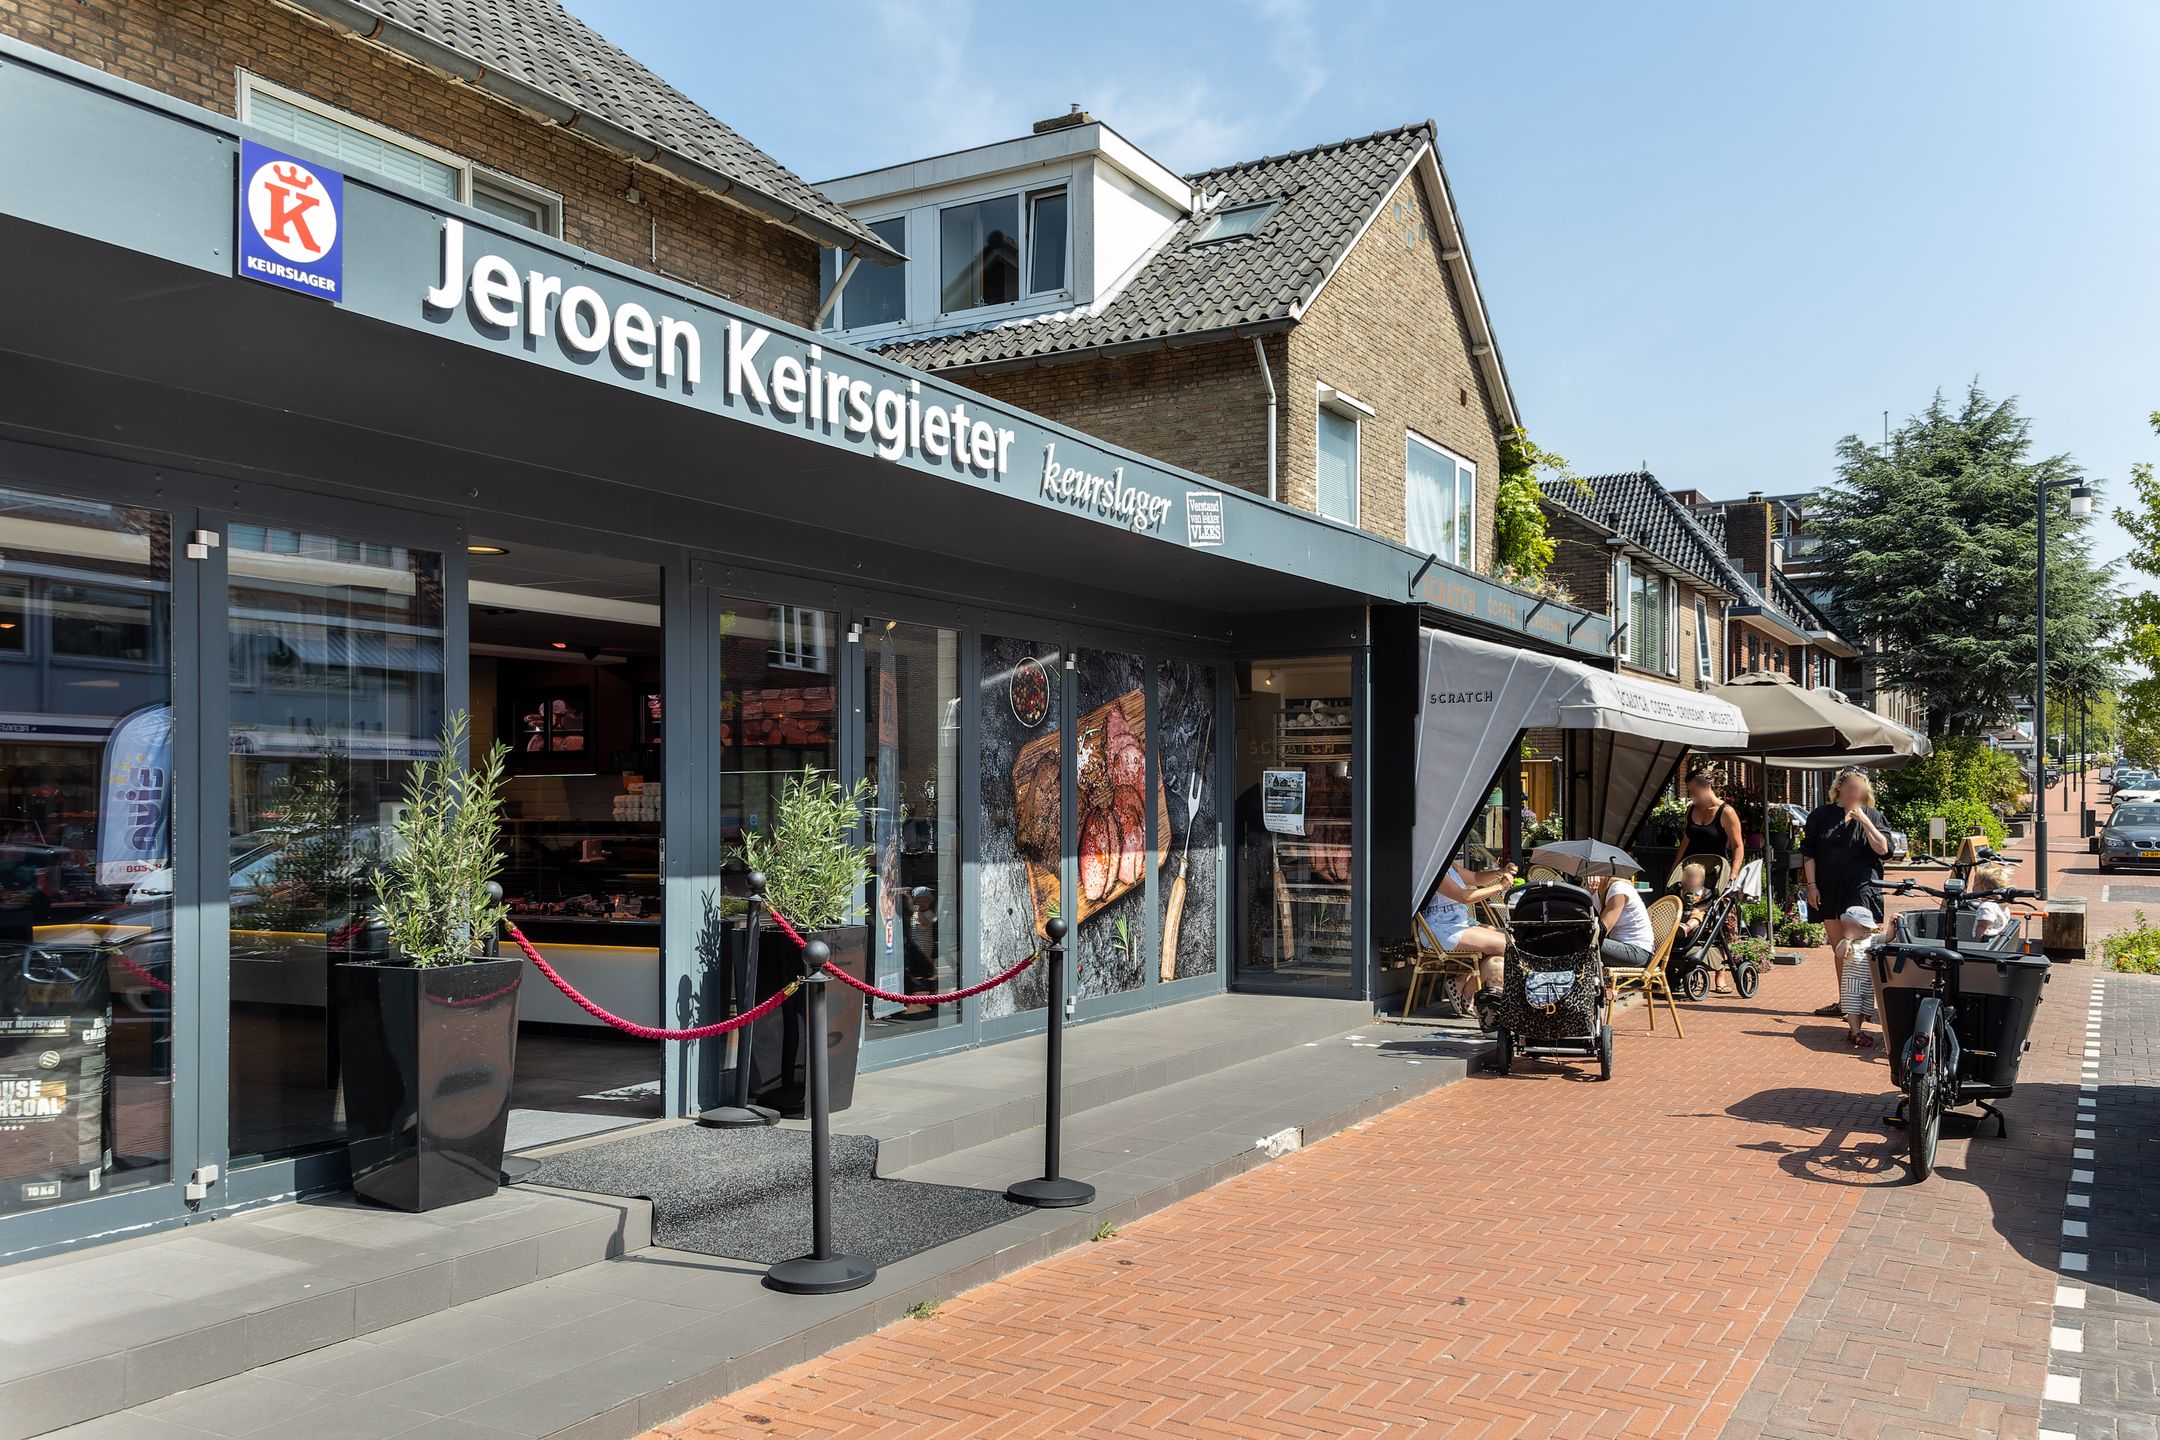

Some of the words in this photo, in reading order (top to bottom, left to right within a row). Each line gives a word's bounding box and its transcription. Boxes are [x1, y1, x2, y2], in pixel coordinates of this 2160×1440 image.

[264, 181, 321, 254] K
[247, 255, 336, 292] KEURSLAGER
[427, 217, 701, 385] Jeroen
[728, 318, 1015, 474] Keirsgieter
[1044, 442, 1172, 531] keurslager
[1190, 499, 1219, 512] Verstand
[1190, 514, 1201, 523] van
[1190, 525, 1221, 540] VLEES
[1423, 574, 1476, 614] SCRATCH
[1430, 691, 1493, 704] SCRATCH
[0, 1080, 42, 1098] USE
[27, 1186, 39, 1197] 10
[40, 1185, 56, 1196] KG
